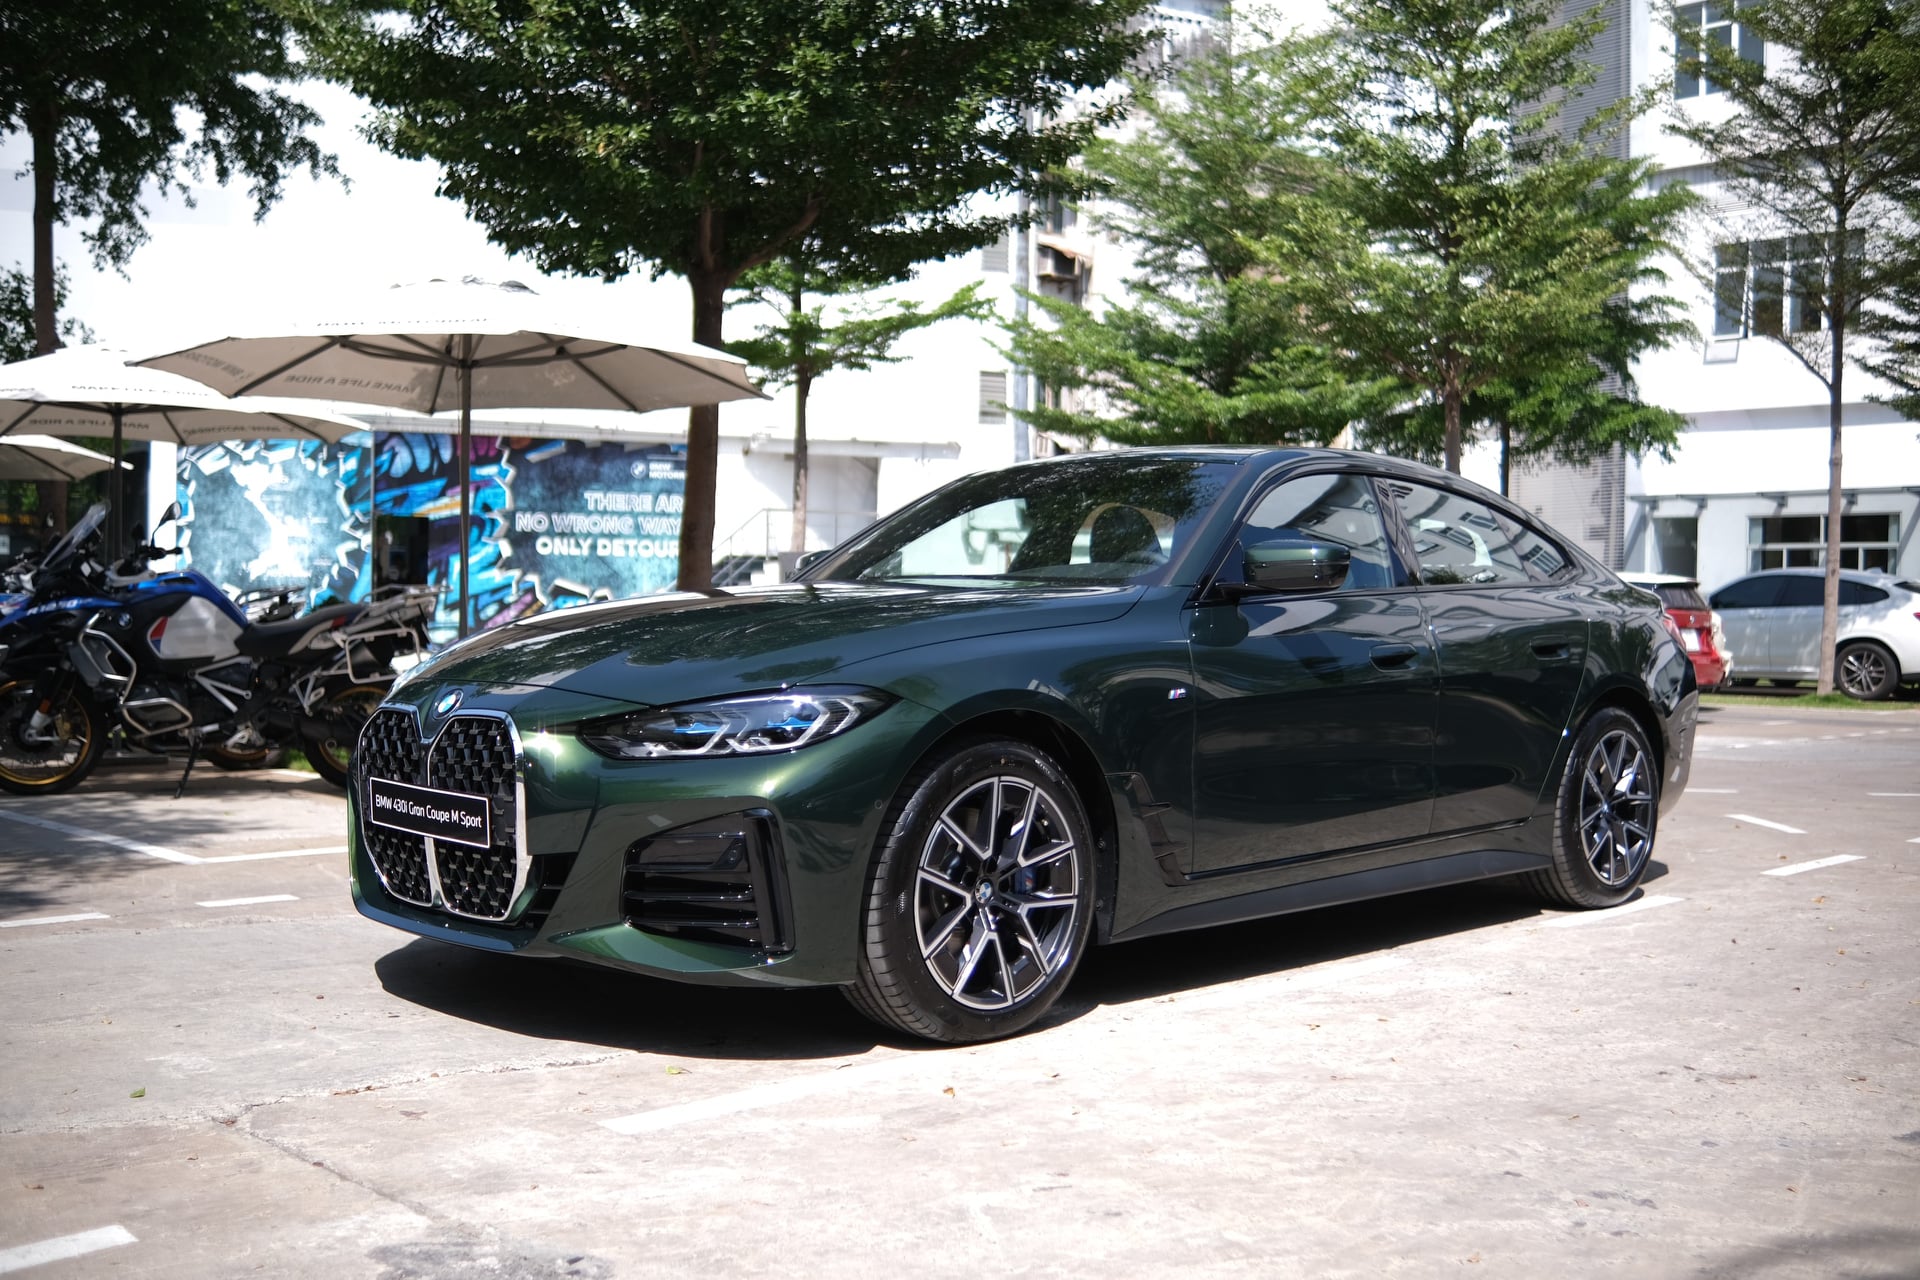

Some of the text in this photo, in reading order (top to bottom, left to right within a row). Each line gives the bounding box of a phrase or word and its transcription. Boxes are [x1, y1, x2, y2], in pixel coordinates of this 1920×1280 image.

[648, 471, 686, 479] MOTORR
[584, 491, 684, 513] THERE AR
[515, 511, 682, 536] NO WRONG WAY
[535, 536, 680, 559] ONLY DETOUR
[375, 794, 482, 829] BMW 430i Gran Coupe M Sport
